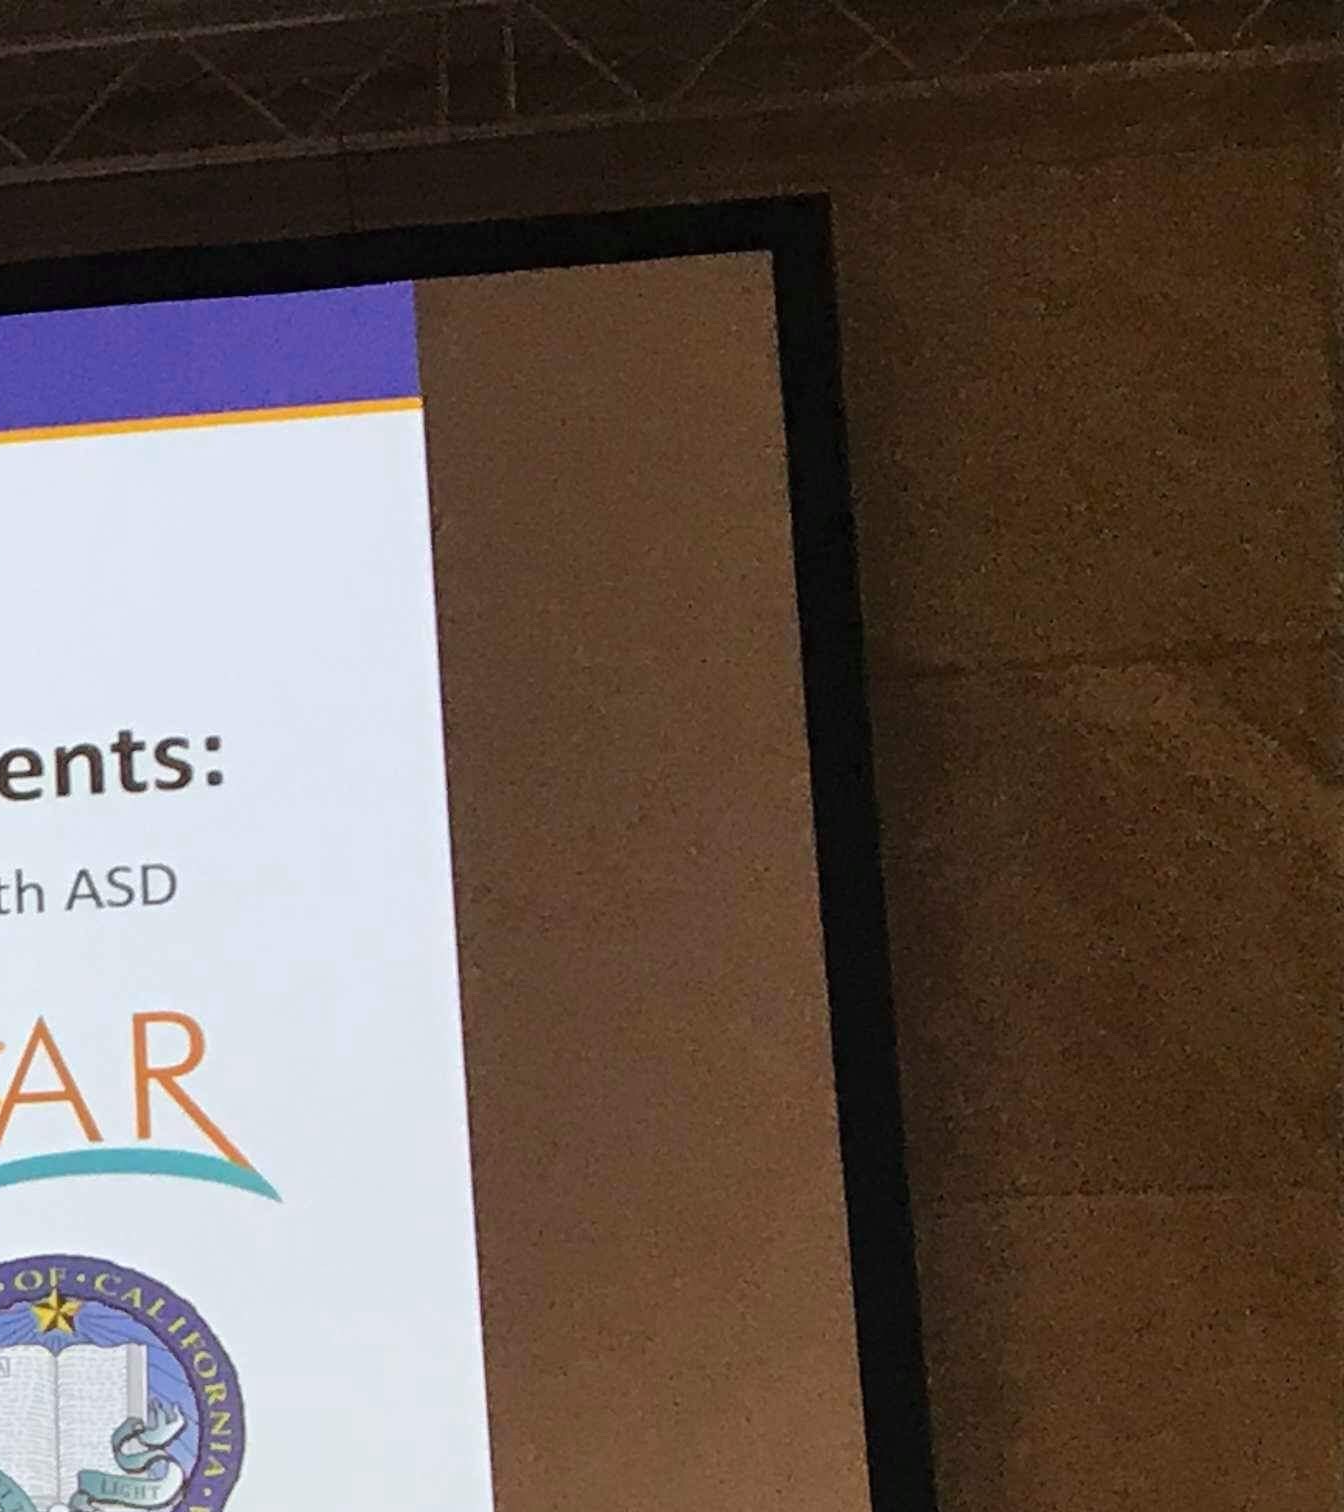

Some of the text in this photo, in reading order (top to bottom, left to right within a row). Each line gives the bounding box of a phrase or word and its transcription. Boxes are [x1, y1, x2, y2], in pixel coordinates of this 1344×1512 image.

[65, 864, 176, 910] ASD
[13, 1266, 68, 1293] OF
[94, 1272, 233, 1479] CALIFORNIA
[101, 1477, 160, 1500] LIGHT
